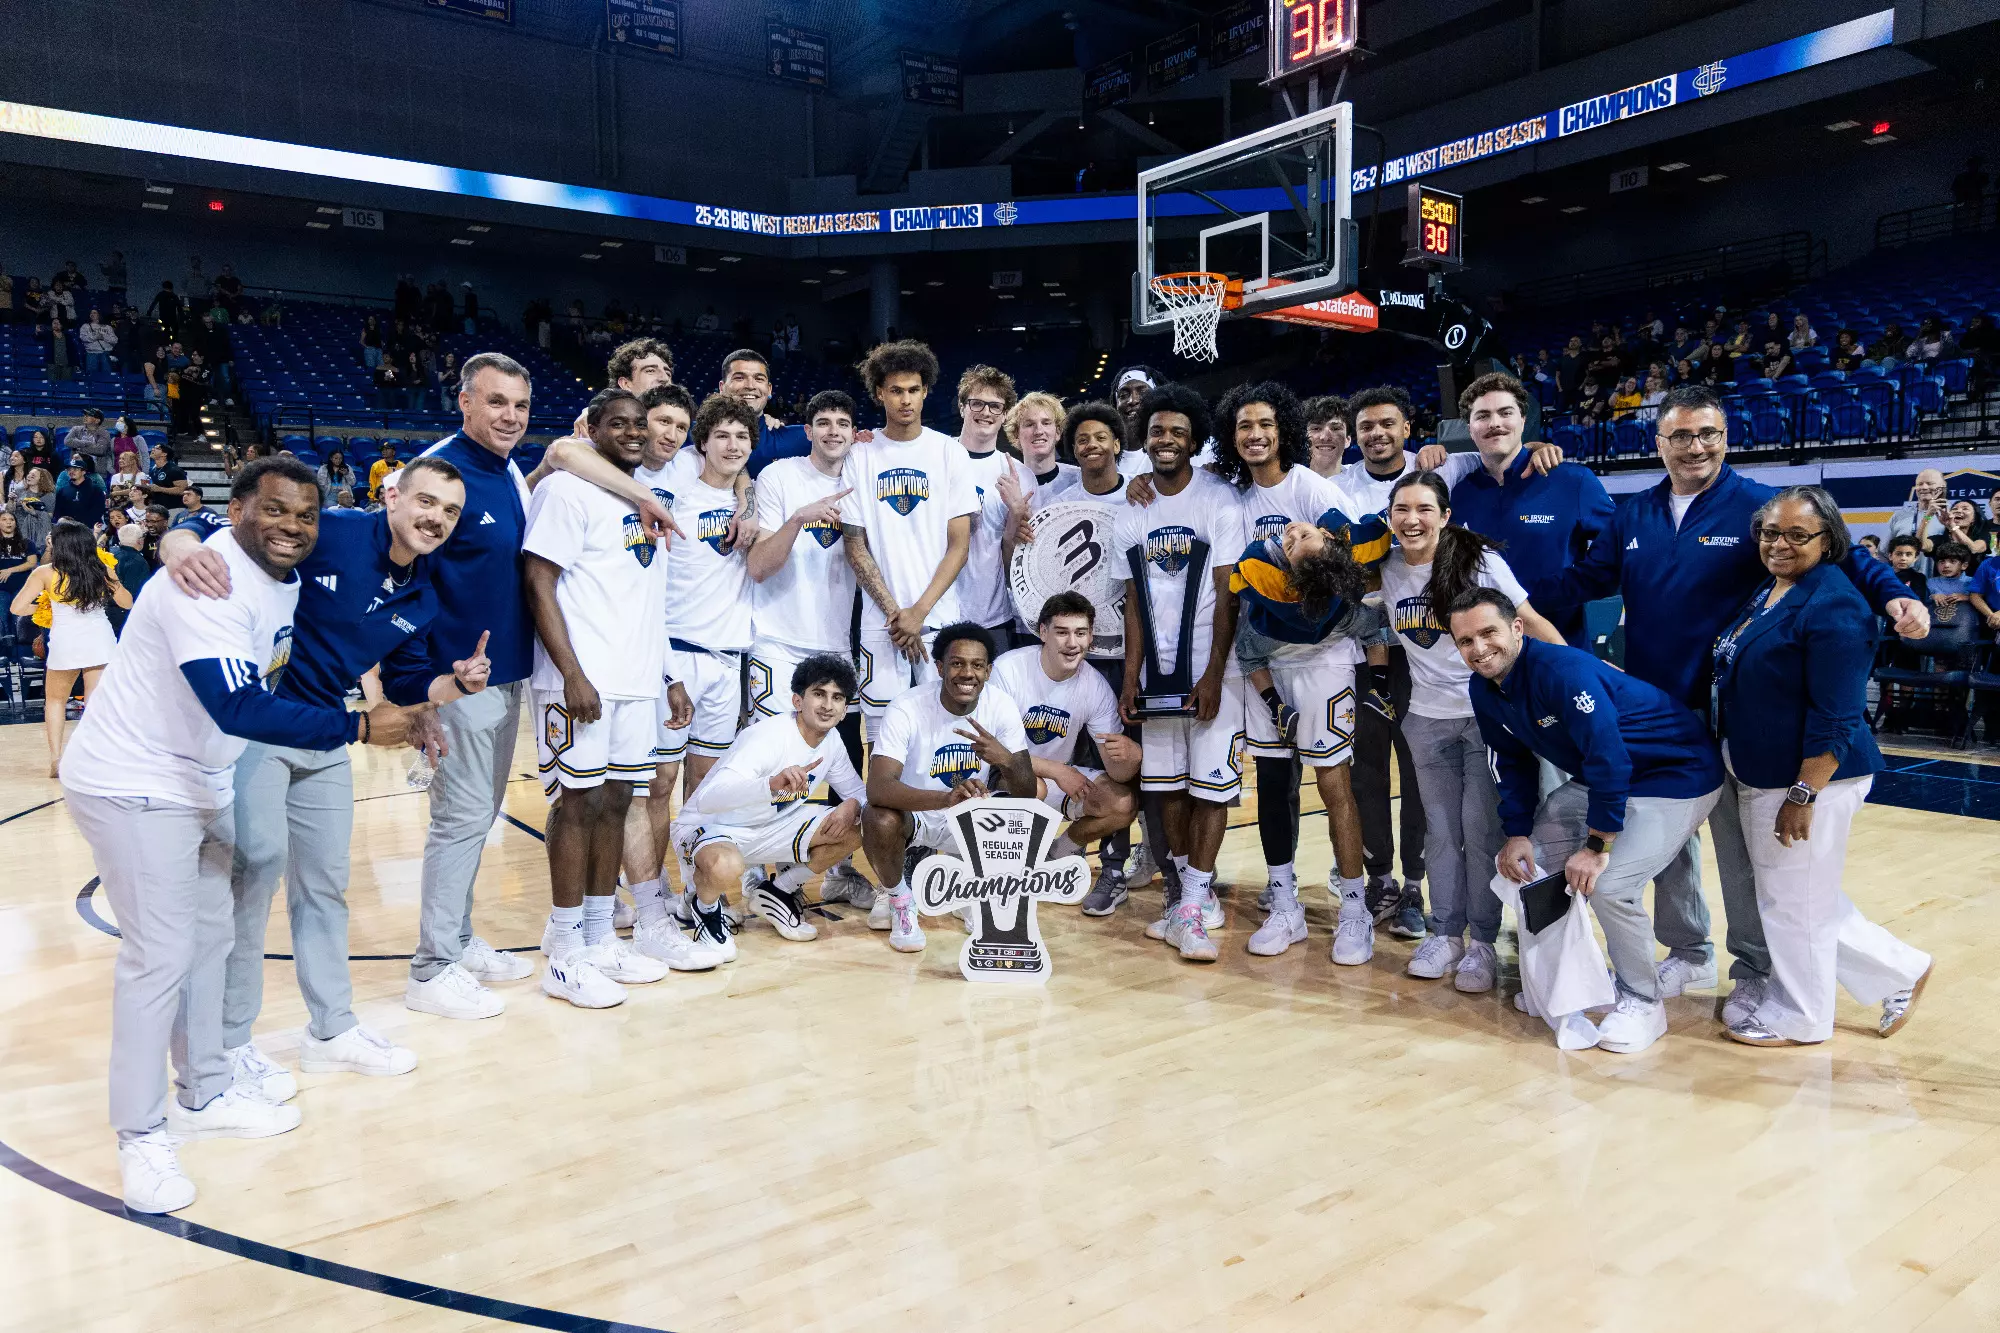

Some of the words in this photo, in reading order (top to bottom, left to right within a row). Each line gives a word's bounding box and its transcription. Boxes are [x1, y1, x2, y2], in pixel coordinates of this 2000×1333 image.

[1228, 14, 1264, 40] IRVINE
[1291, 0, 1343, 61] 30
[1164, 46, 1198, 69] IRVINE
[1099, 72, 1130, 93] IRVINE
[1353, 163, 1385, 192] 25-2
[1385, 158, 1404, 183] BIG
[1405, 148, 1439, 177] WEST
[1440, 131, 1494, 167] REGULAR
[1495, 115, 1547, 151] SEASON
[1563, 77, 1671, 133] CHAMPIONS
[351, 211, 376, 226] 105
[695, 205, 730, 227] 25-26
[731, 210, 750, 231] BIG
[751, 214, 781, 235] WEST
[783, 213, 835, 236] REGULAR
[836, 212, 881, 233] SEASON
[894, 206, 978, 231] CHAMPIONS
[1426, 223, 1448, 253] 30
[662, 250, 681, 262] 106
[877, 475, 929, 499] CHAMPIONS
[1023, 711, 1069, 737] CHAMPIONS
[1008, 812, 1024, 820] THE
[1008, 820, 1023, 828] BIG
[1007, 827, 1030, 835] WEST
[982, 840, 1024, 851] REGULAR
[985, 850, 1021, 860] SEASON
[925, 867, 1081, 907] Champions
